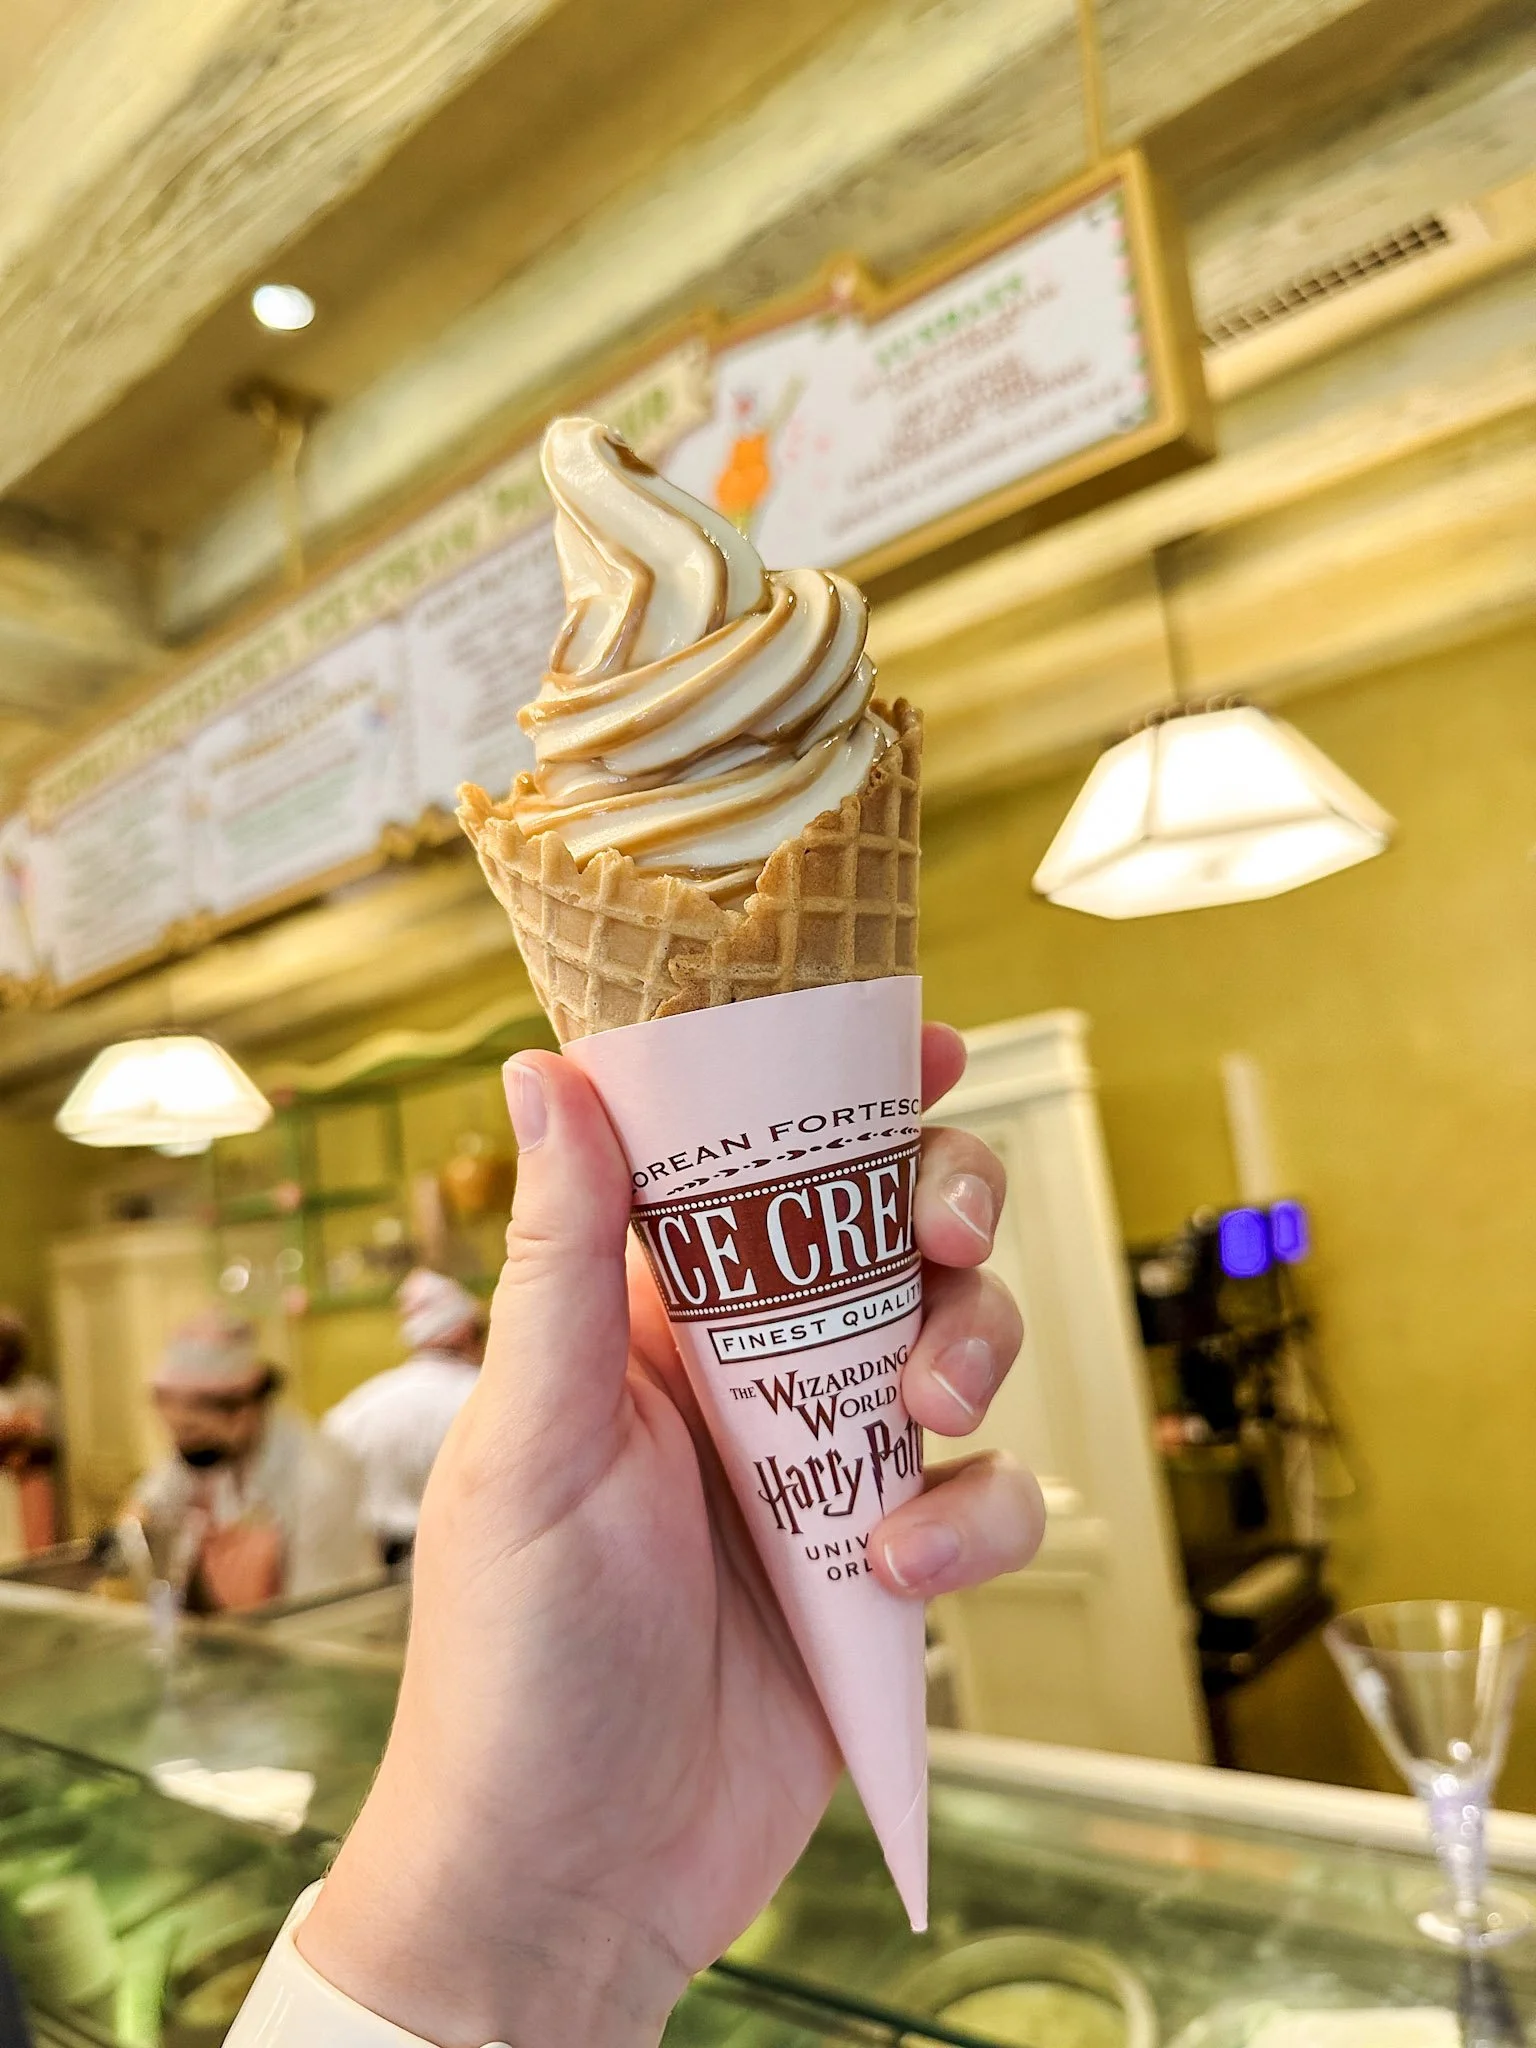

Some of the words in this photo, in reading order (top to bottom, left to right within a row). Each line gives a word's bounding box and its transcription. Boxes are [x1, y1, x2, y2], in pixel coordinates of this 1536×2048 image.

[639, 1206, 757, 1305] ICE
[723, 1319, 826, 1352] FINEST
[730, 1387, 757, 1400] THE
[750, 1344, 908, 1416] WIZARDING
[793, 1385, 897, 1441] WORLD
[753, 1448, 864, 1535] Harry
[806, 1532, 869, 1561] UNIV
[827, 1557, 873, 1581] ORL
